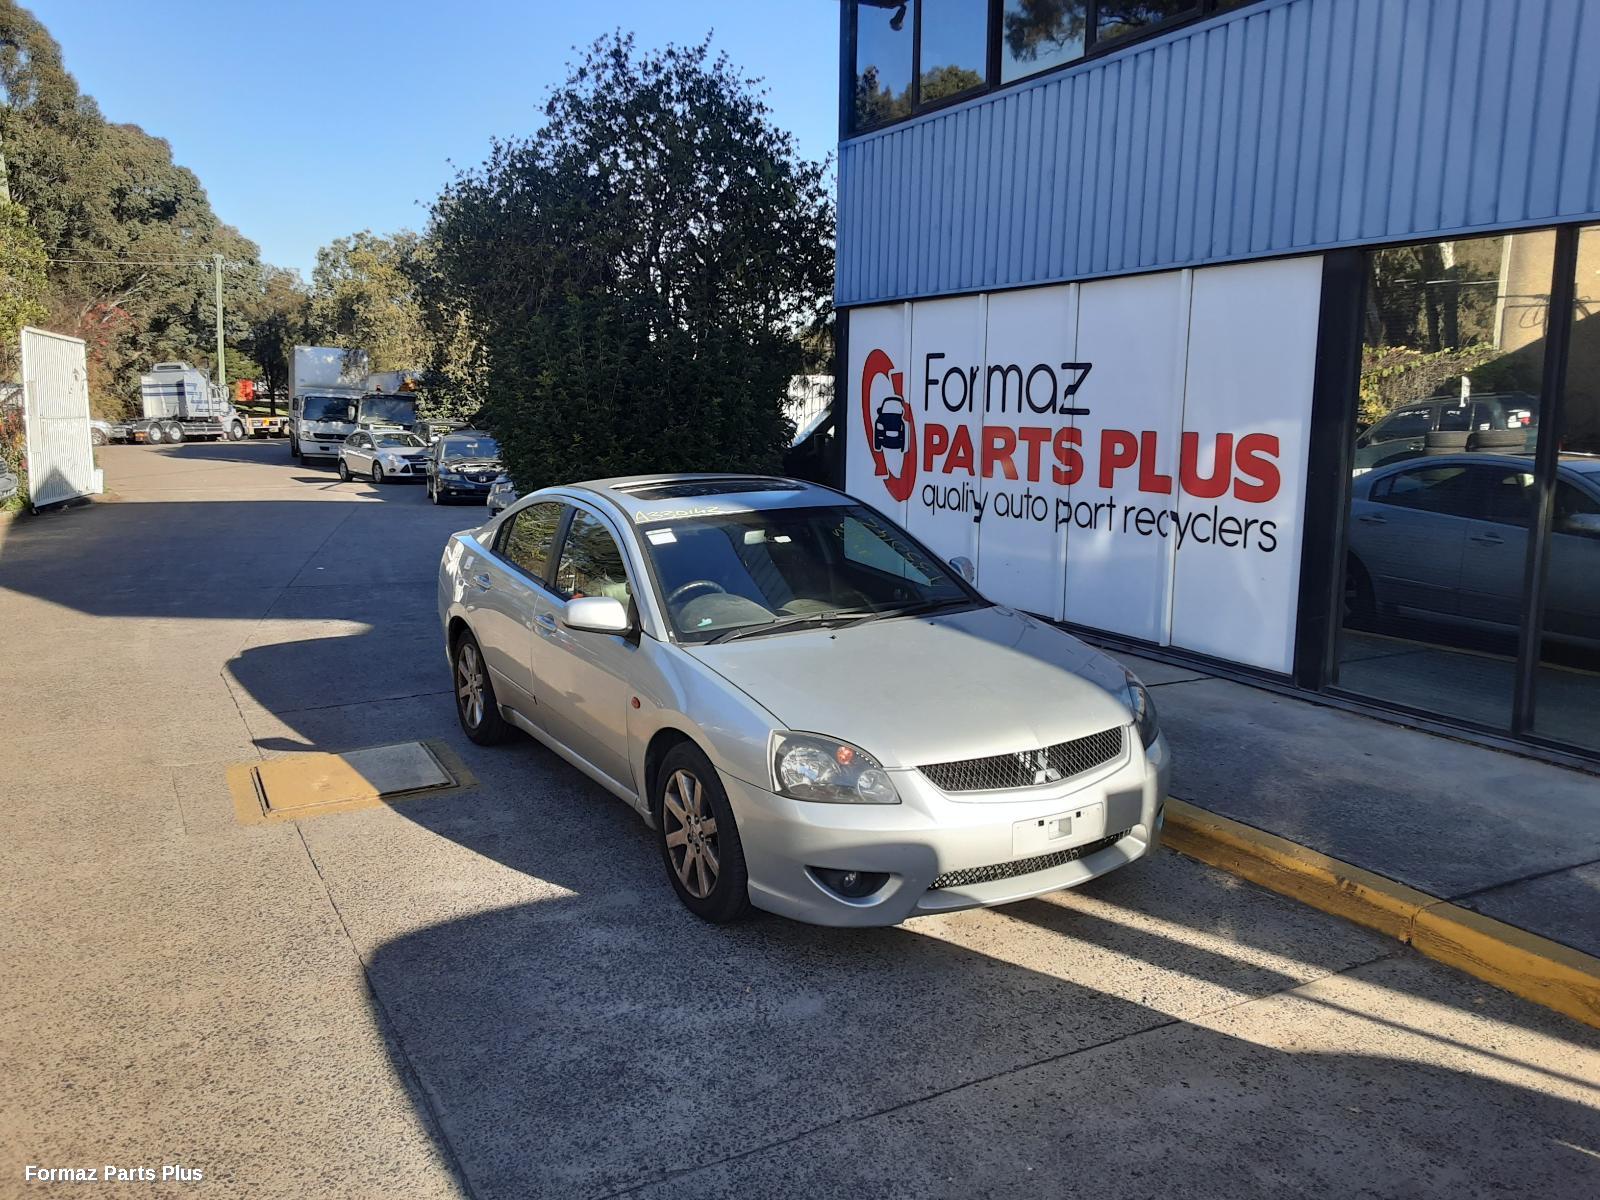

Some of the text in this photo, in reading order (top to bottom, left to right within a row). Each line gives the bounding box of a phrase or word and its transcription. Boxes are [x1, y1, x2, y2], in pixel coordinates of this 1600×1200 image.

[924, 352, 1093, 416] Formaz
[923, 423, 1281, 504] PARTS PLUS
[994, 487, 1048, 521] auto
[1055, 495, 1117, 532] part
[1123, 504, 1277, 552] recyclers
